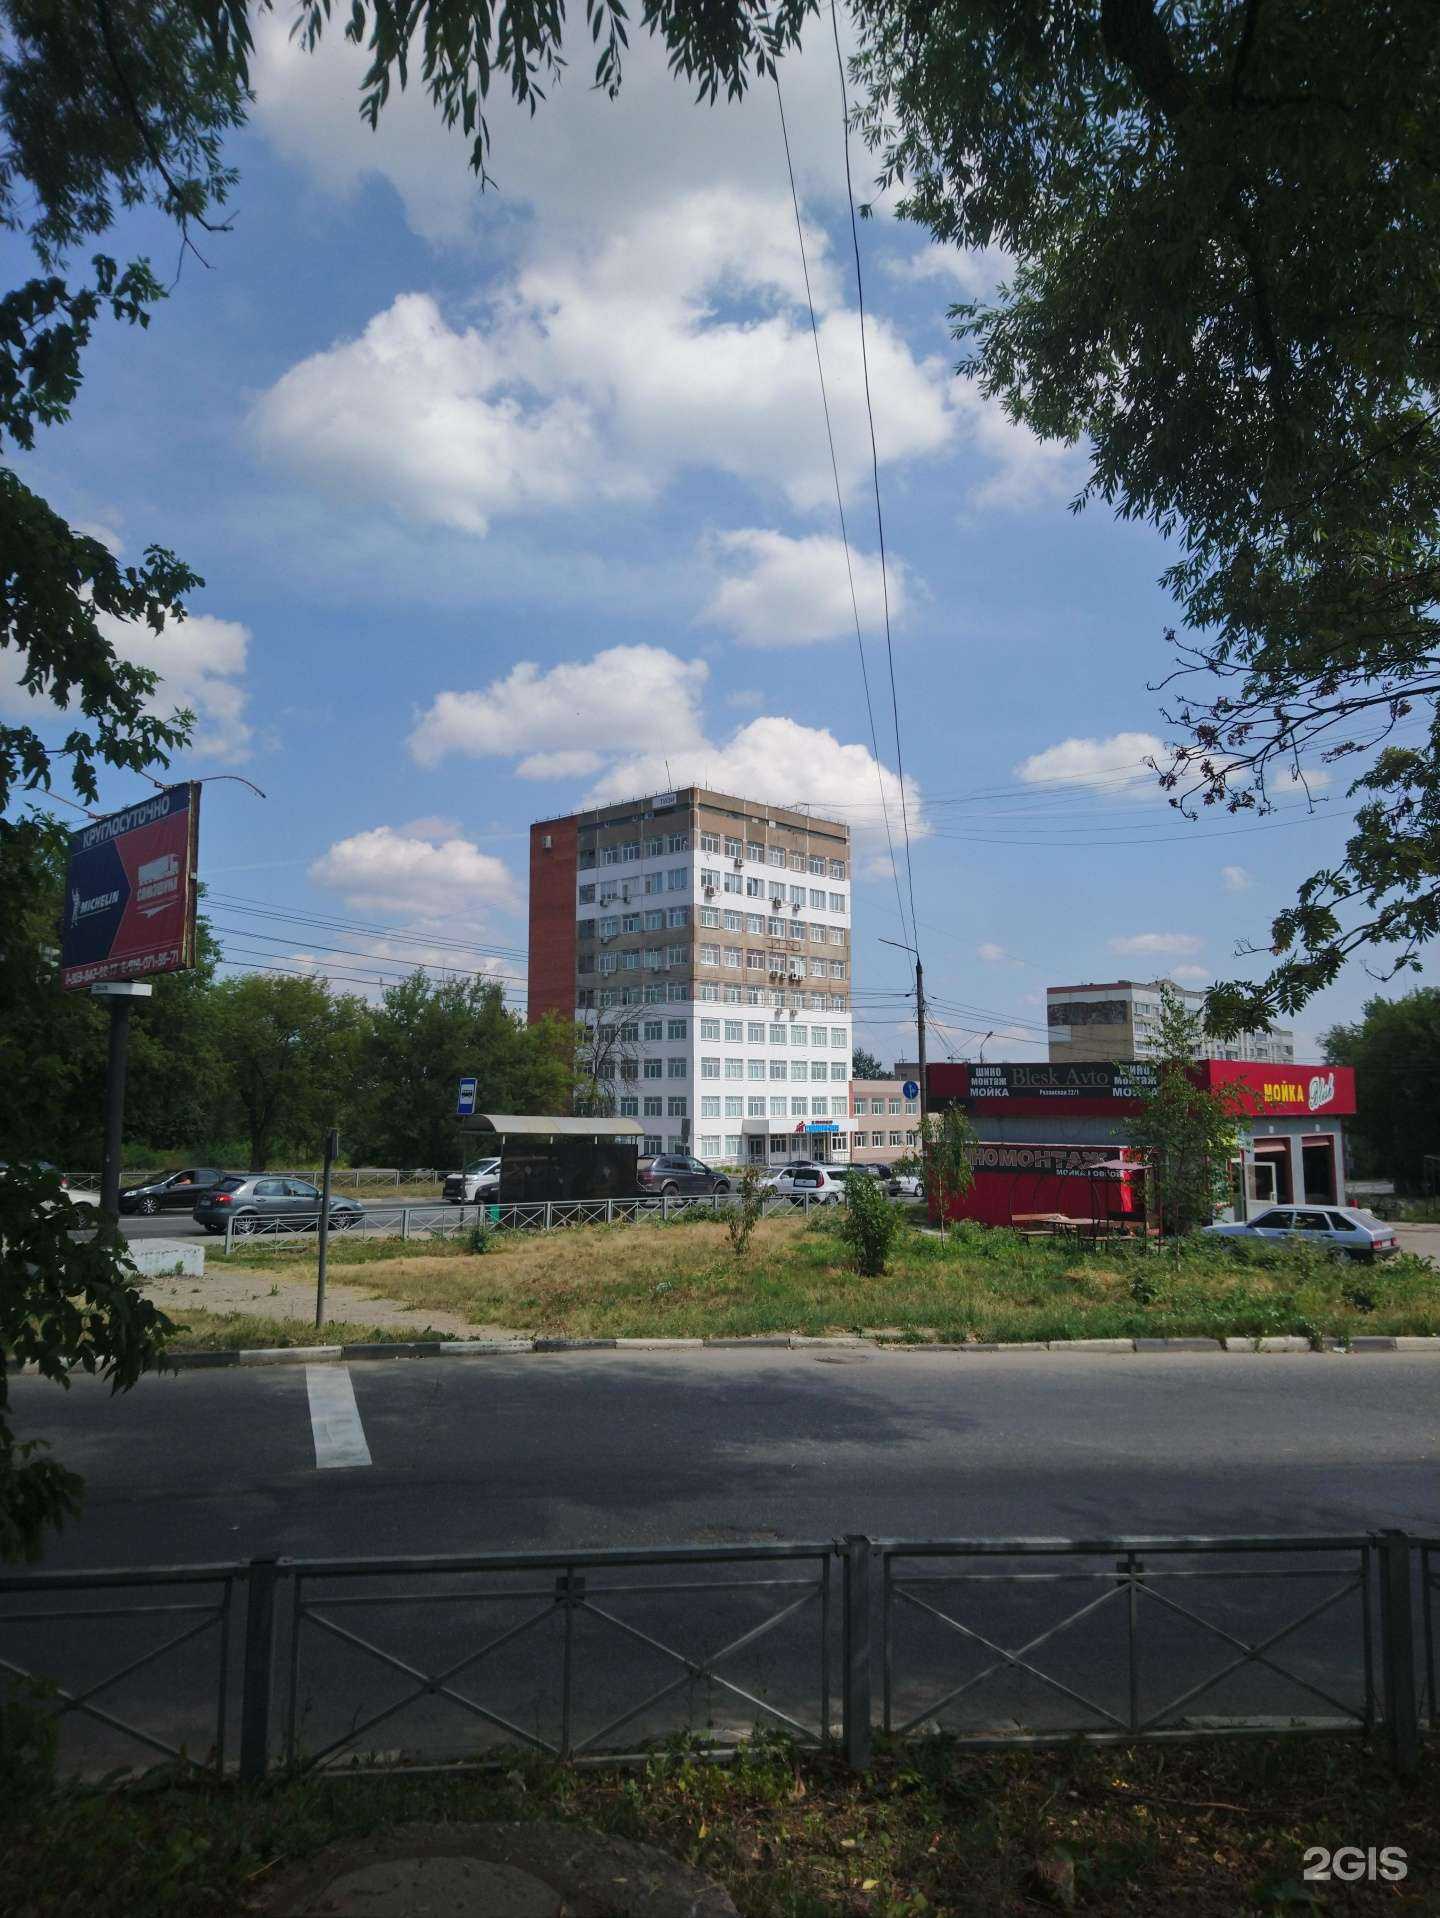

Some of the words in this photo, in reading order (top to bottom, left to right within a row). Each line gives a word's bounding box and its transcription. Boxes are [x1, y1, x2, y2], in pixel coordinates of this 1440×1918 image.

[82, 796, 170, 848] КРУГЛОСУТОЧНО
[79, 890, 120, 913] MICHELIN
[1011, 1067, 1058, 1085] Blesk
[1065, 1067, 1109, 1085] Avto
[970, 1086, 1010, 1097] МОЙКА
[1264, 1080, 1304, 1102] МОЙКА
